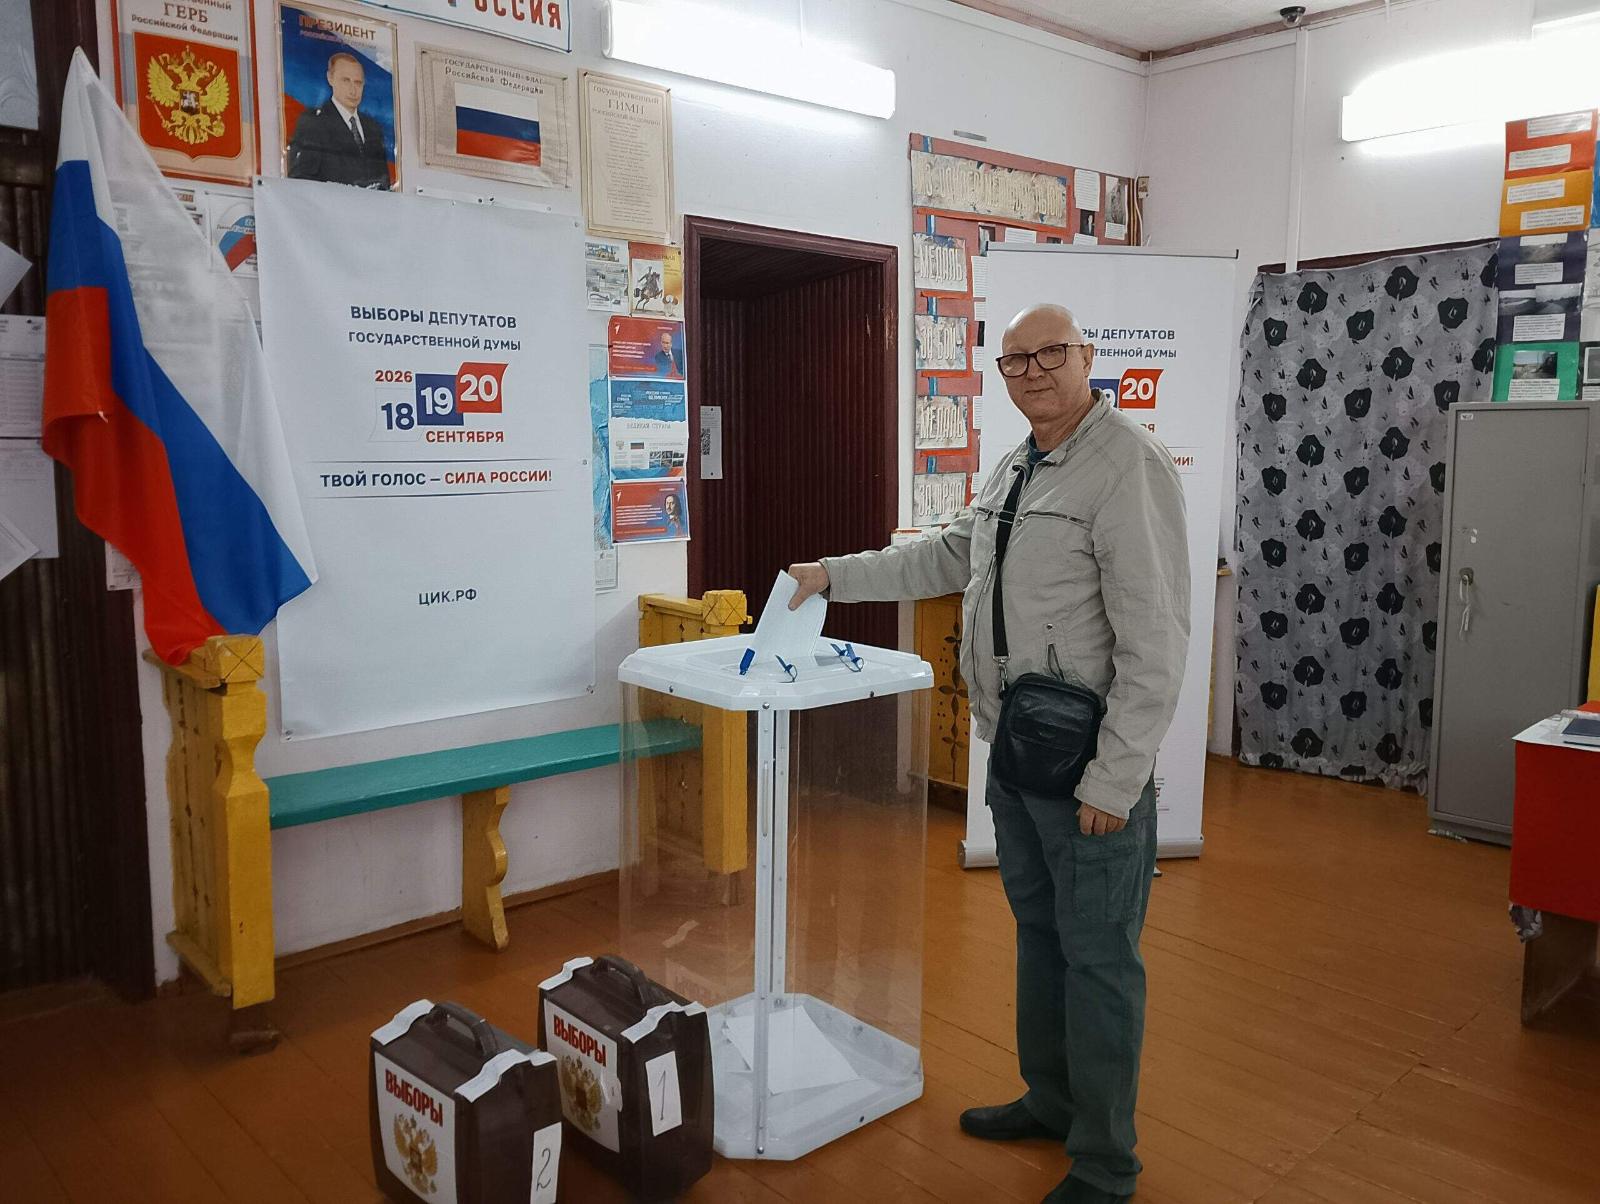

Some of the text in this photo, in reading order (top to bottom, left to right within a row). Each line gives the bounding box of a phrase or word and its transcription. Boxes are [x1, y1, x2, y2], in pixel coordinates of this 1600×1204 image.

[164, 3, 208, 23] ГЕРБ
[298, 14, 377, 40] ПРЕЗИДЕНТ
[920, 245, 963, 282] МЕДАЛЬ
[350, 306, 517, 329] ВЫБОРЫ ДЕПУТАТОВ
[348, 332, 521, 351] ГОСУДАРСТВЕННОЙ ДУМЫ
[1101, 329, 1176, 340] ДЕПУТАТОВ
[1145, 349, 1177, 359] ДУМЫ
[375, 370, 413, 383] 2026
[1121, 377, 1155, 400] 20
[381, 374, 499, 430] 18 19 20
[426, 431, 505, 443] СЕНТЯБРЯ
[320, 471, 367, 487] ТВОЙ
[372, 473, 427, 486] ГОЛОС
[444, 472, 486, 484] СИЛА
[490, 470, 552, 483] РОССИИ!
[419, 588, 477, 607] ЦИК.РФ
[553, 1014, 607, 1068] ВЫБОРЫ
[385, 1068, 444, 1128] ВЫБОРЫ
[657, 1069, 667, 1121] 1
[536, 1147, 552, 1192] 2
